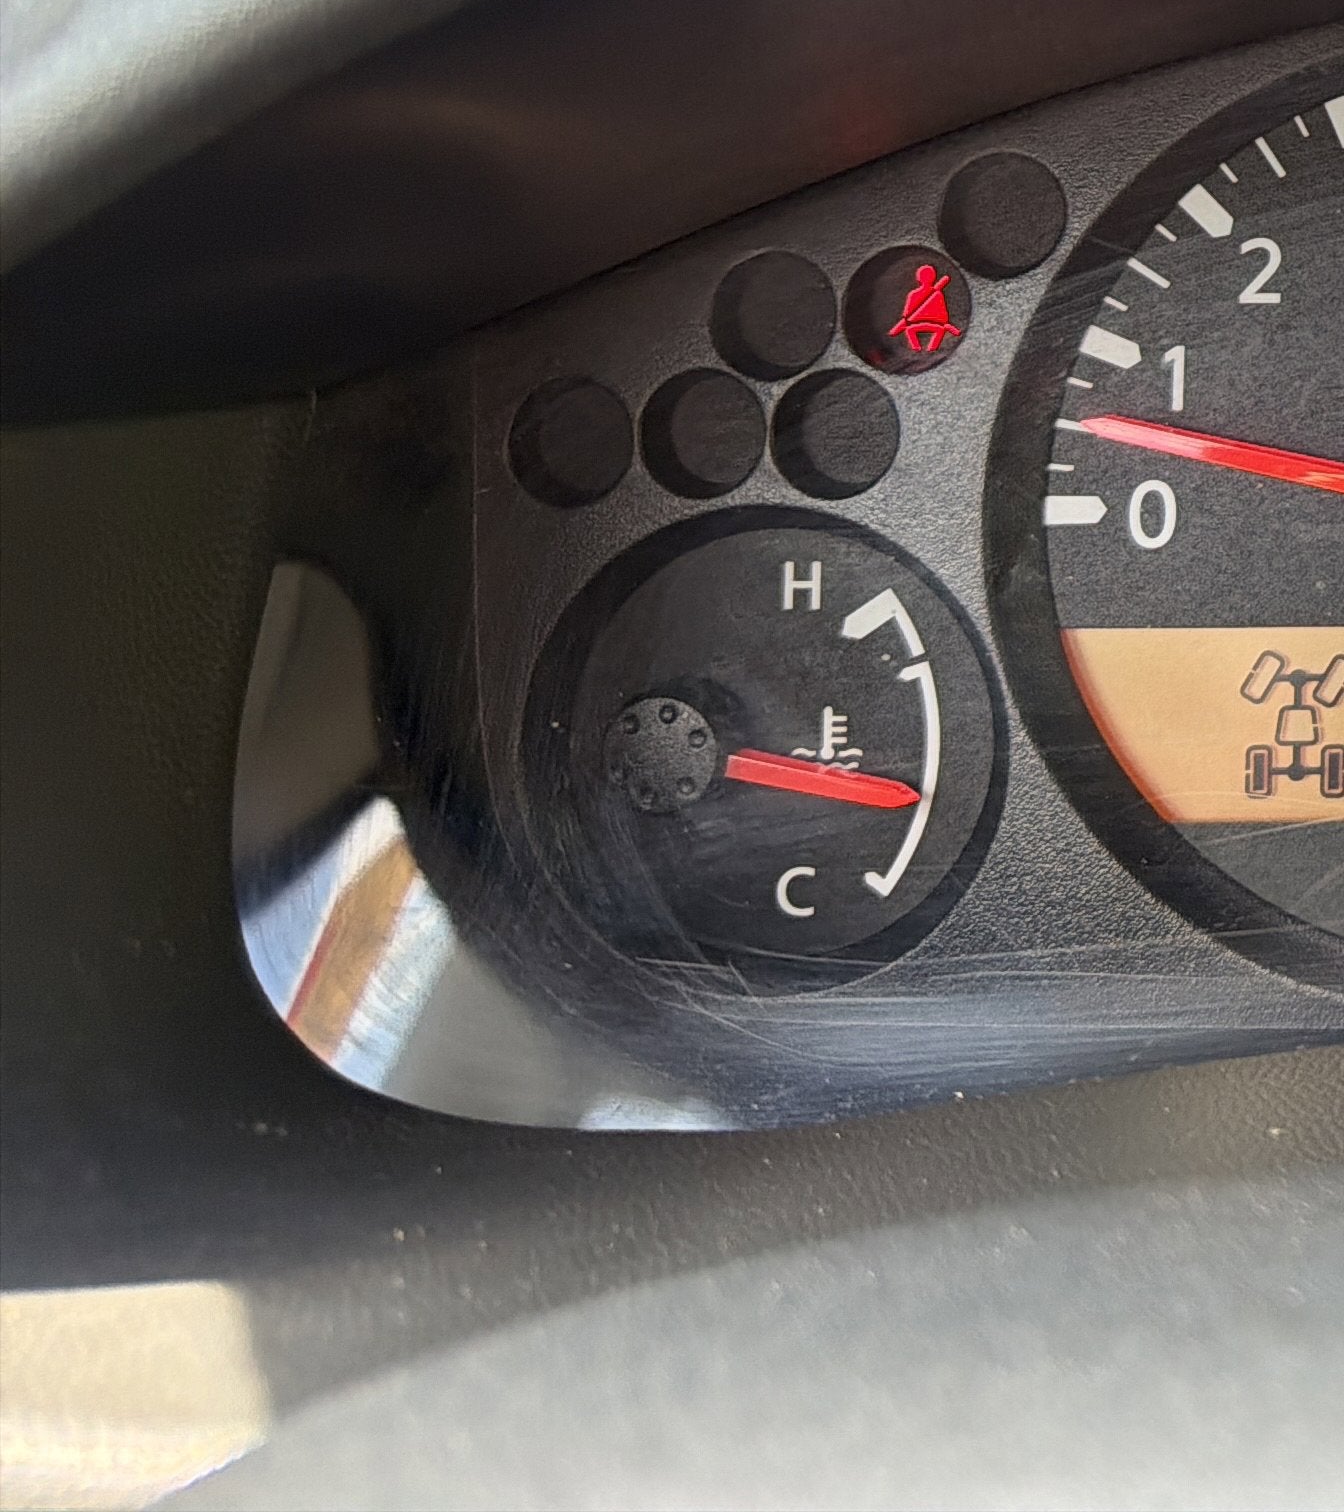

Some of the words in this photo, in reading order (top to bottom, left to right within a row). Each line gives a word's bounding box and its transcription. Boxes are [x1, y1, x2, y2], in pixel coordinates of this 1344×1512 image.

[1239, 238, 1281, 303] 2
[1163, 346, 1185, 411] 1
[1129, 480, 1176, 548] 0
[784, 561, 821, 610] H
[777, 867, 815, 916] C
